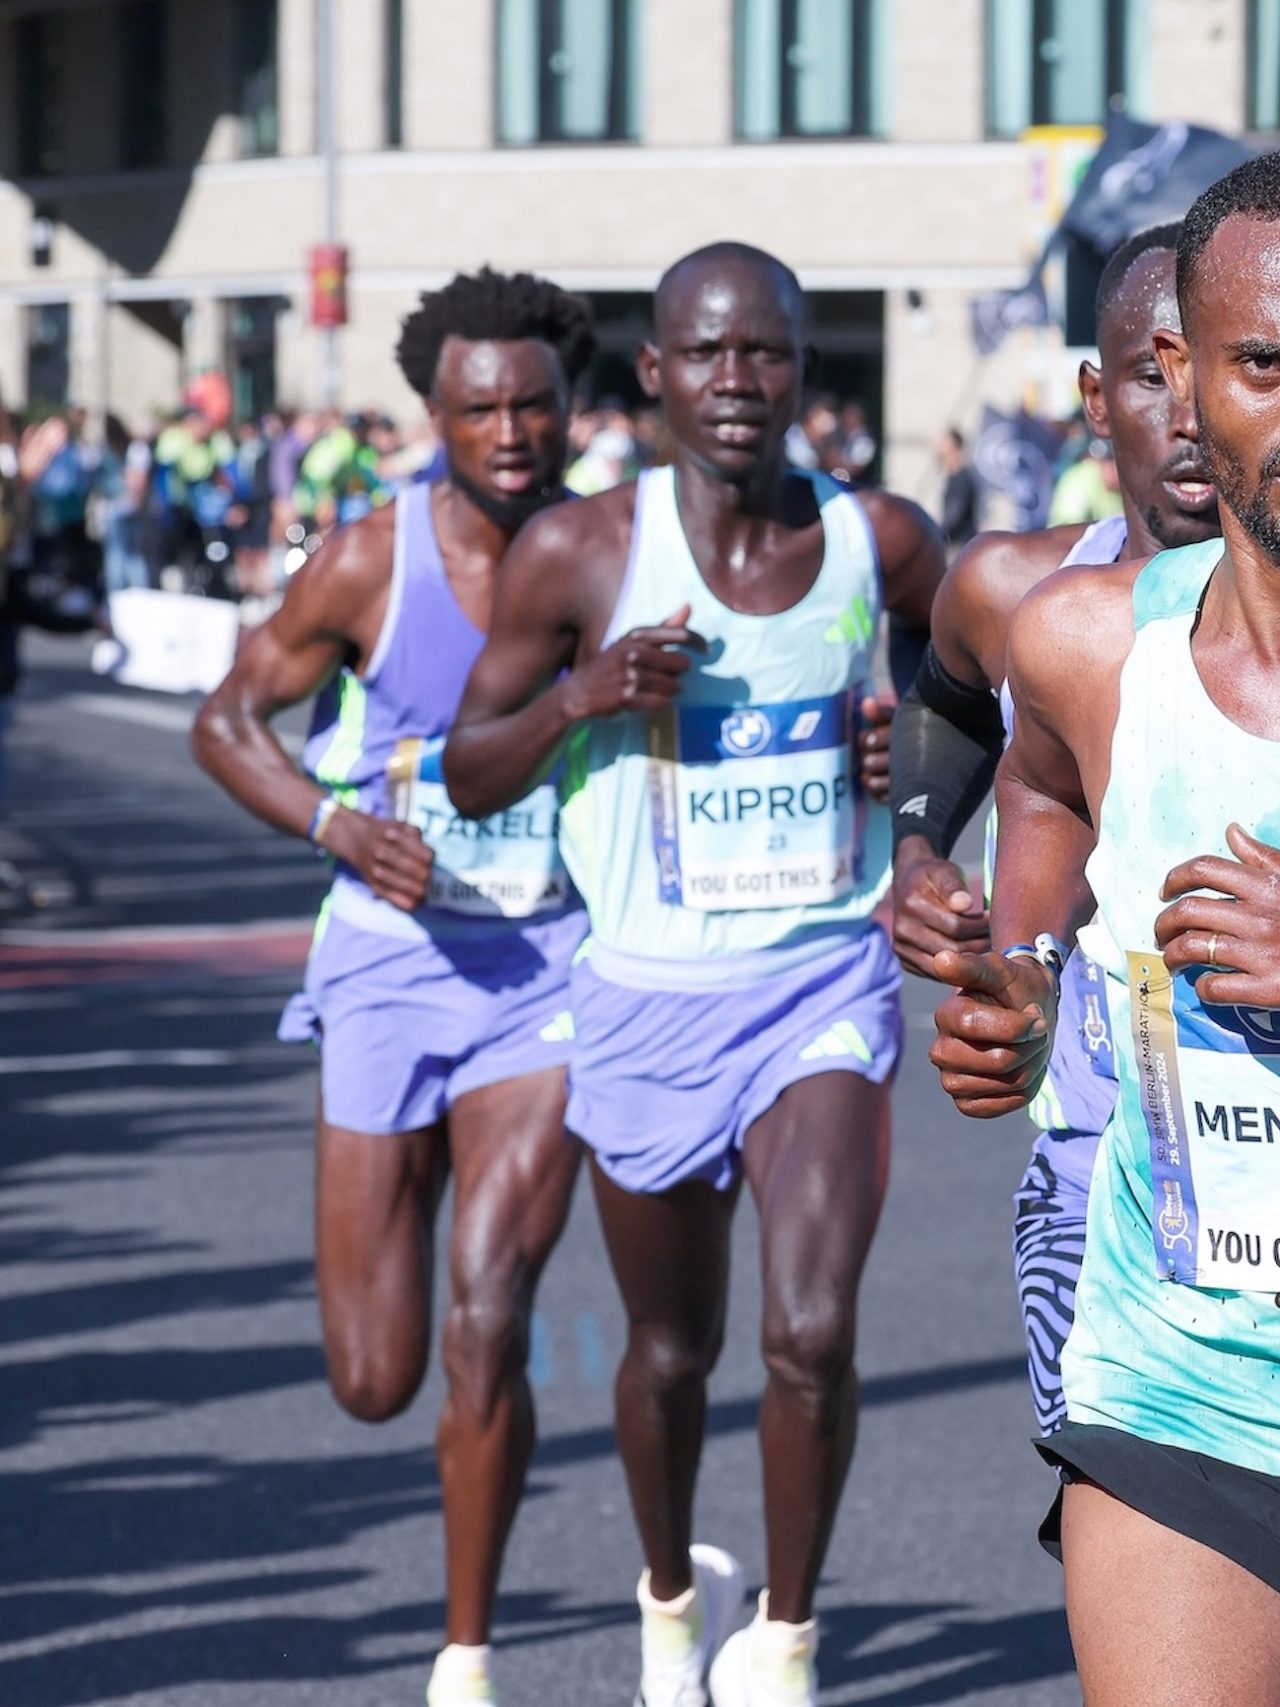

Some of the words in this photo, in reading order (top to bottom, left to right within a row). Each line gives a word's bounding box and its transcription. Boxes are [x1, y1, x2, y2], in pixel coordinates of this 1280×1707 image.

[420, 804, 560, 840] TAKEL
[689, 872, 728, 895] YOU
[735, 871, 772, 893] GOT
[778, 866, 820, 889] THIS
[1156, 1051, 1169, 1082] 2024
[1149, 1111, 1163, 1141] BMW
[1162, 1083, 1179, 1145] September
[1168, 1146, 1181, 1166] 29.
[1207, 1227, 1263, 1267] YOU
